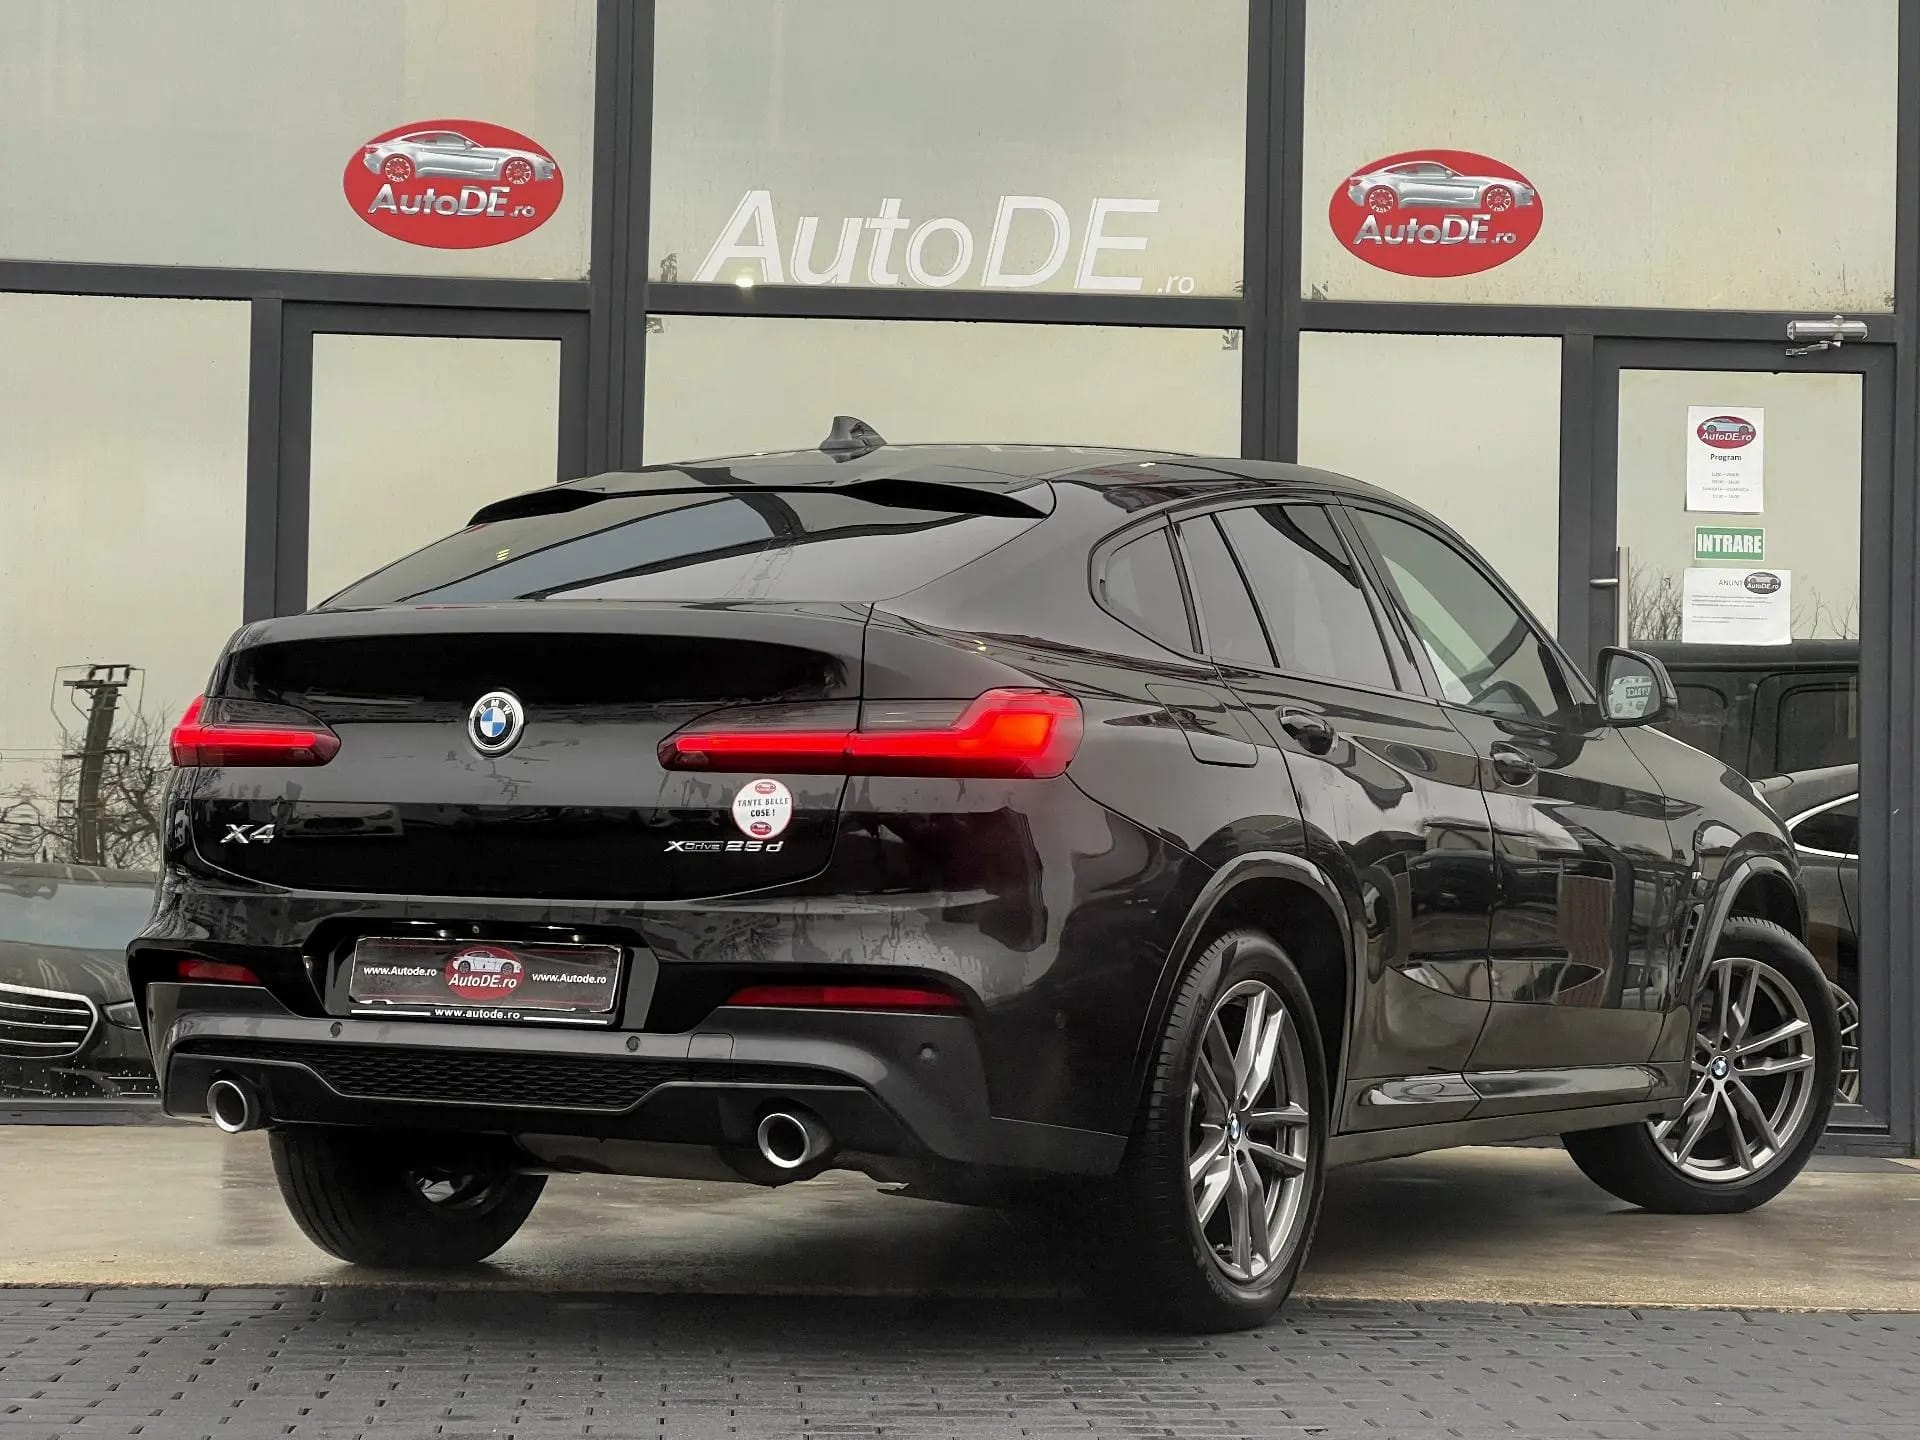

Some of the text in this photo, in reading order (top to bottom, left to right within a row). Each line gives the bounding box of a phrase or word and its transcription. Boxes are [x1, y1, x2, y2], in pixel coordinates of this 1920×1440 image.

[1710, 453, 1742, 462] Program
[1697, 533, 1762, 553] INTRARE
[737, 797, 790, 807] TANTE BELLE
[220, 823, 276, 844] X4
[363, 964, 438, 977] www.Autode.ro
[447, 972, 518, 989] AutoDE.ro
[531, 972, 608, 985] www.Autode.ro
[434, 1007, 521, 1020] www.autode.ro
